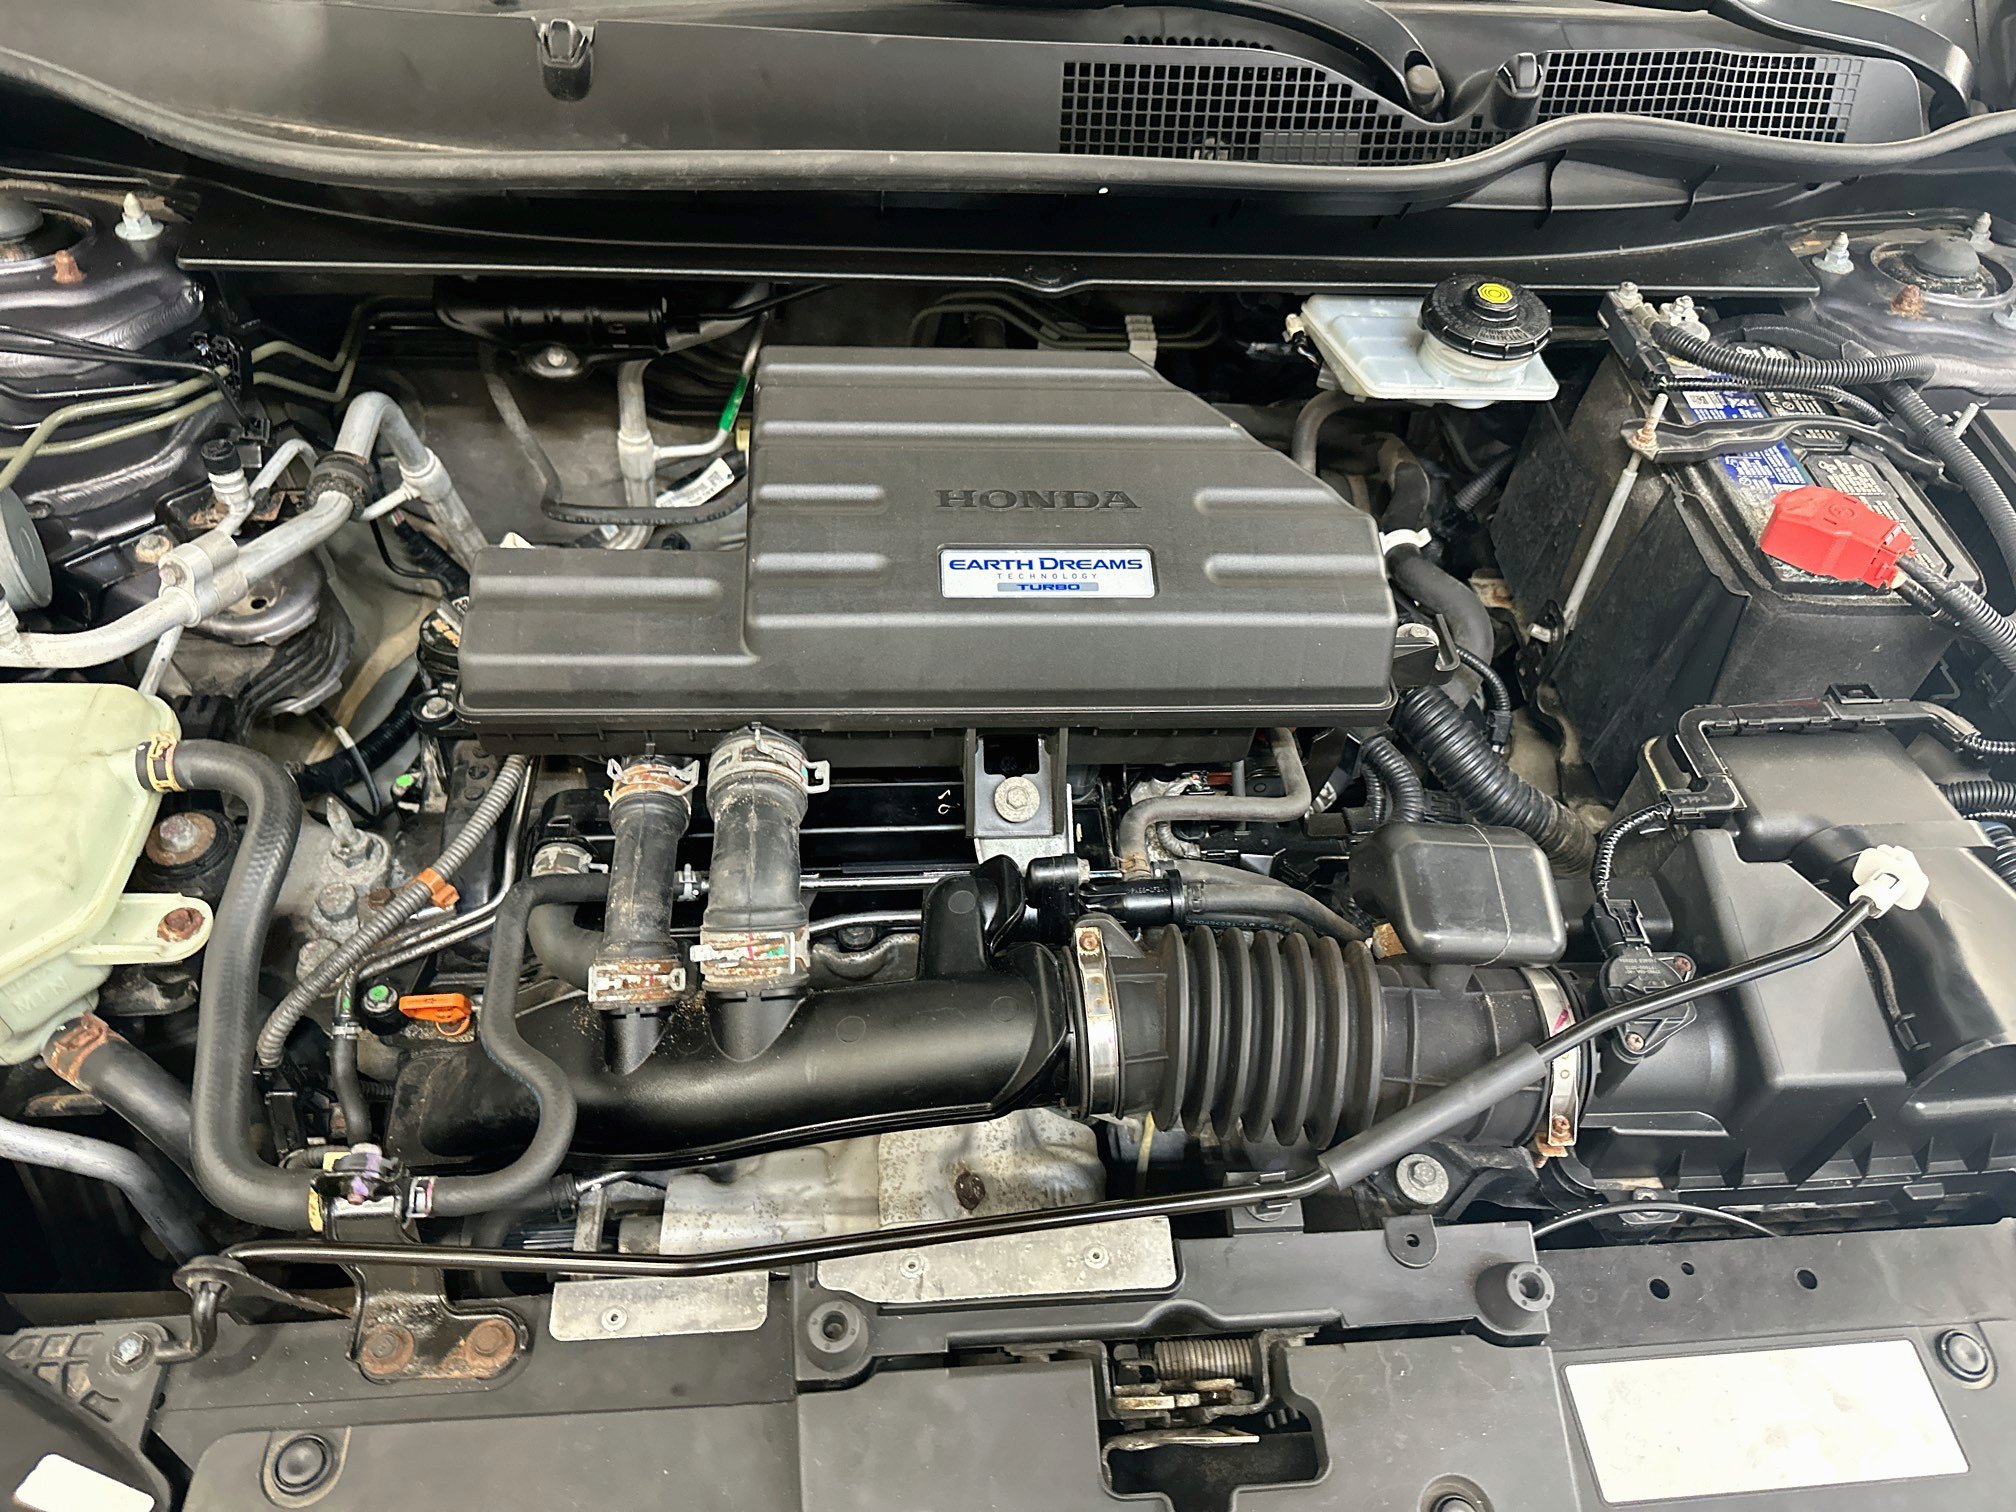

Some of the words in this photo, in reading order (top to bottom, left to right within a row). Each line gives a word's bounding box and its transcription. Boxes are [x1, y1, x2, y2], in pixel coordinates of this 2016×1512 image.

[936, 490, 1142, 508] HONDA
[949, 559, 1033, 570] EARTH
[1039, 557, 1143, 570] DREAMS
[1016, 583, 1081, 591] TURBO
